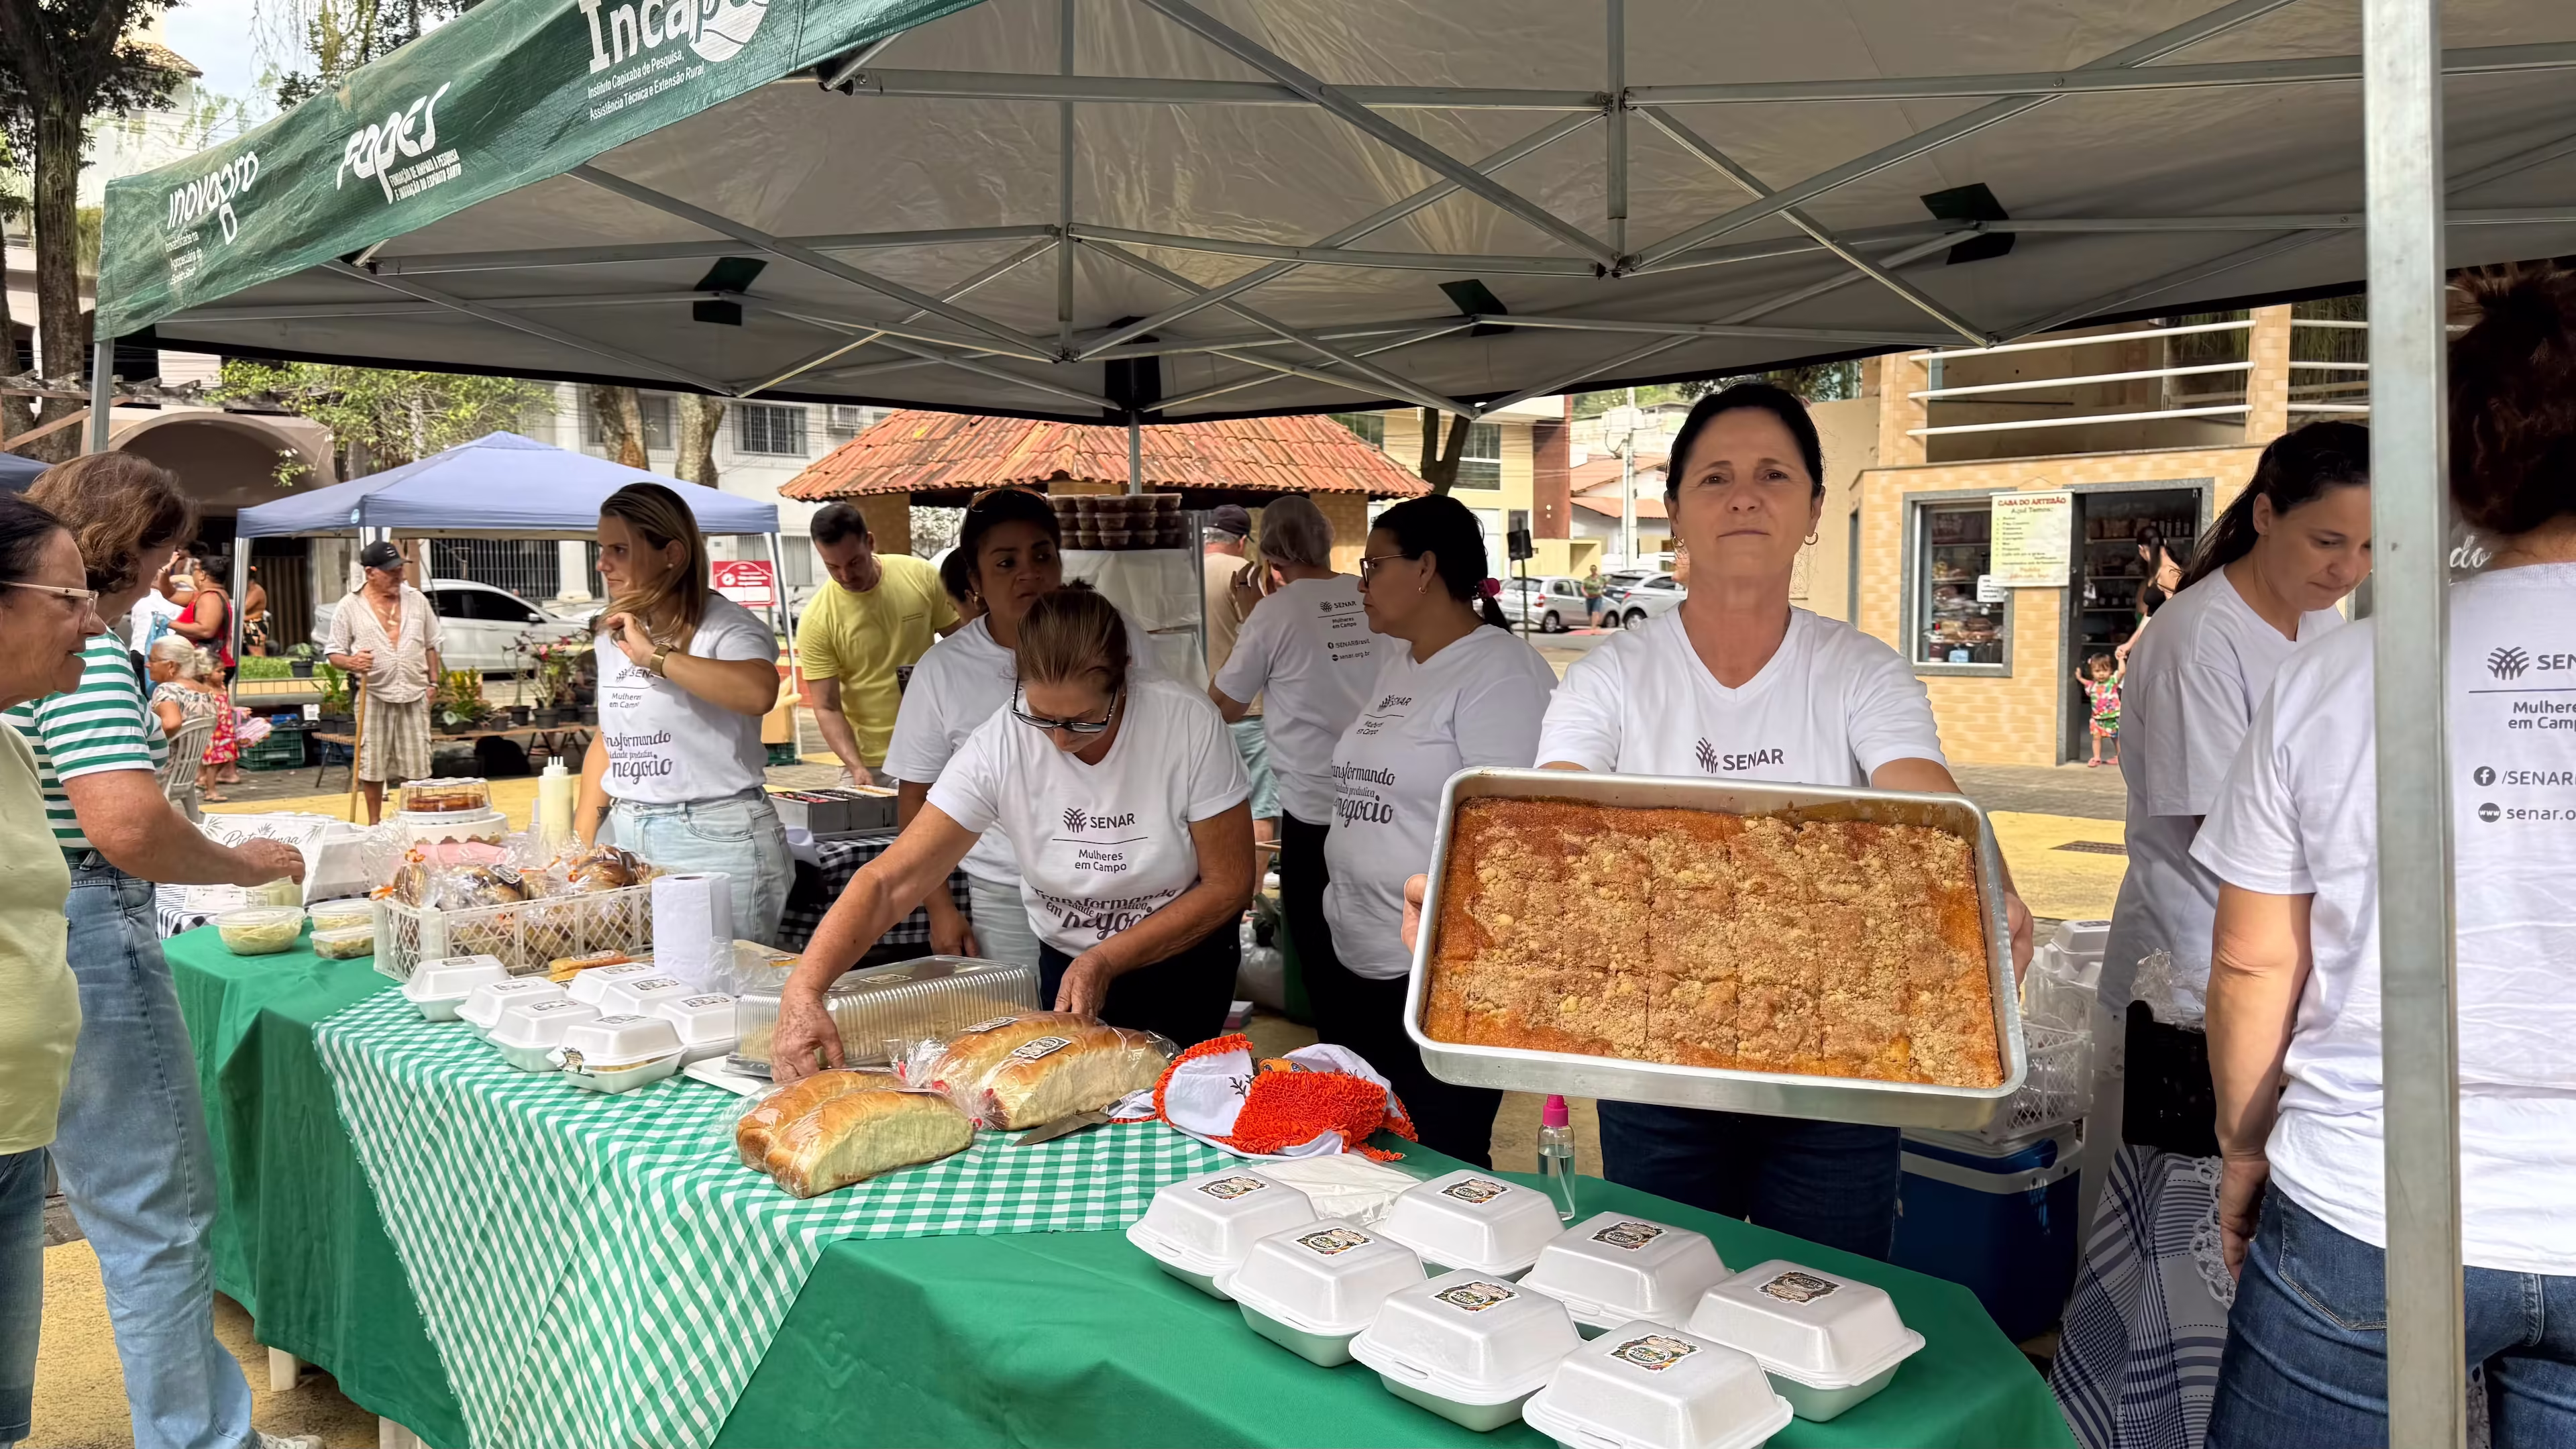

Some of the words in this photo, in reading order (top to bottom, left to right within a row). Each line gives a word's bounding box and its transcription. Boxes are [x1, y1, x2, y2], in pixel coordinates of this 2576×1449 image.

[588, 80, 612, 99] Instituto
[612, 66, 642, 89] Capixaba
[642, 62, 651, 76] de
[651, 50, 685, 70] Pesquisa,
[590, 97, 624, 121] Assistência
[623, 87, 649, 107] Técnica
[649, 88, 653, 97] e
[654, 72, 685, 94] Extensão
[686, 61, 704, 81] Rural
[1334, 600, 1356, 608] SENAR
[2508, 718, 2533, 729] em
[2537, 716, 2576, 732] Cam
[1722, 748, 1784, 771] SENAR
[2502, 771, 2576, 786] /SENAR
[1089, 813, 1136, 829] SENAR
[1079, 849, 1123, 861] Mulheres
[1075, 861, 1091, 870] em
[1093, 861, 1127, 873] Campo
[1046, 902, 1063, 918] em
